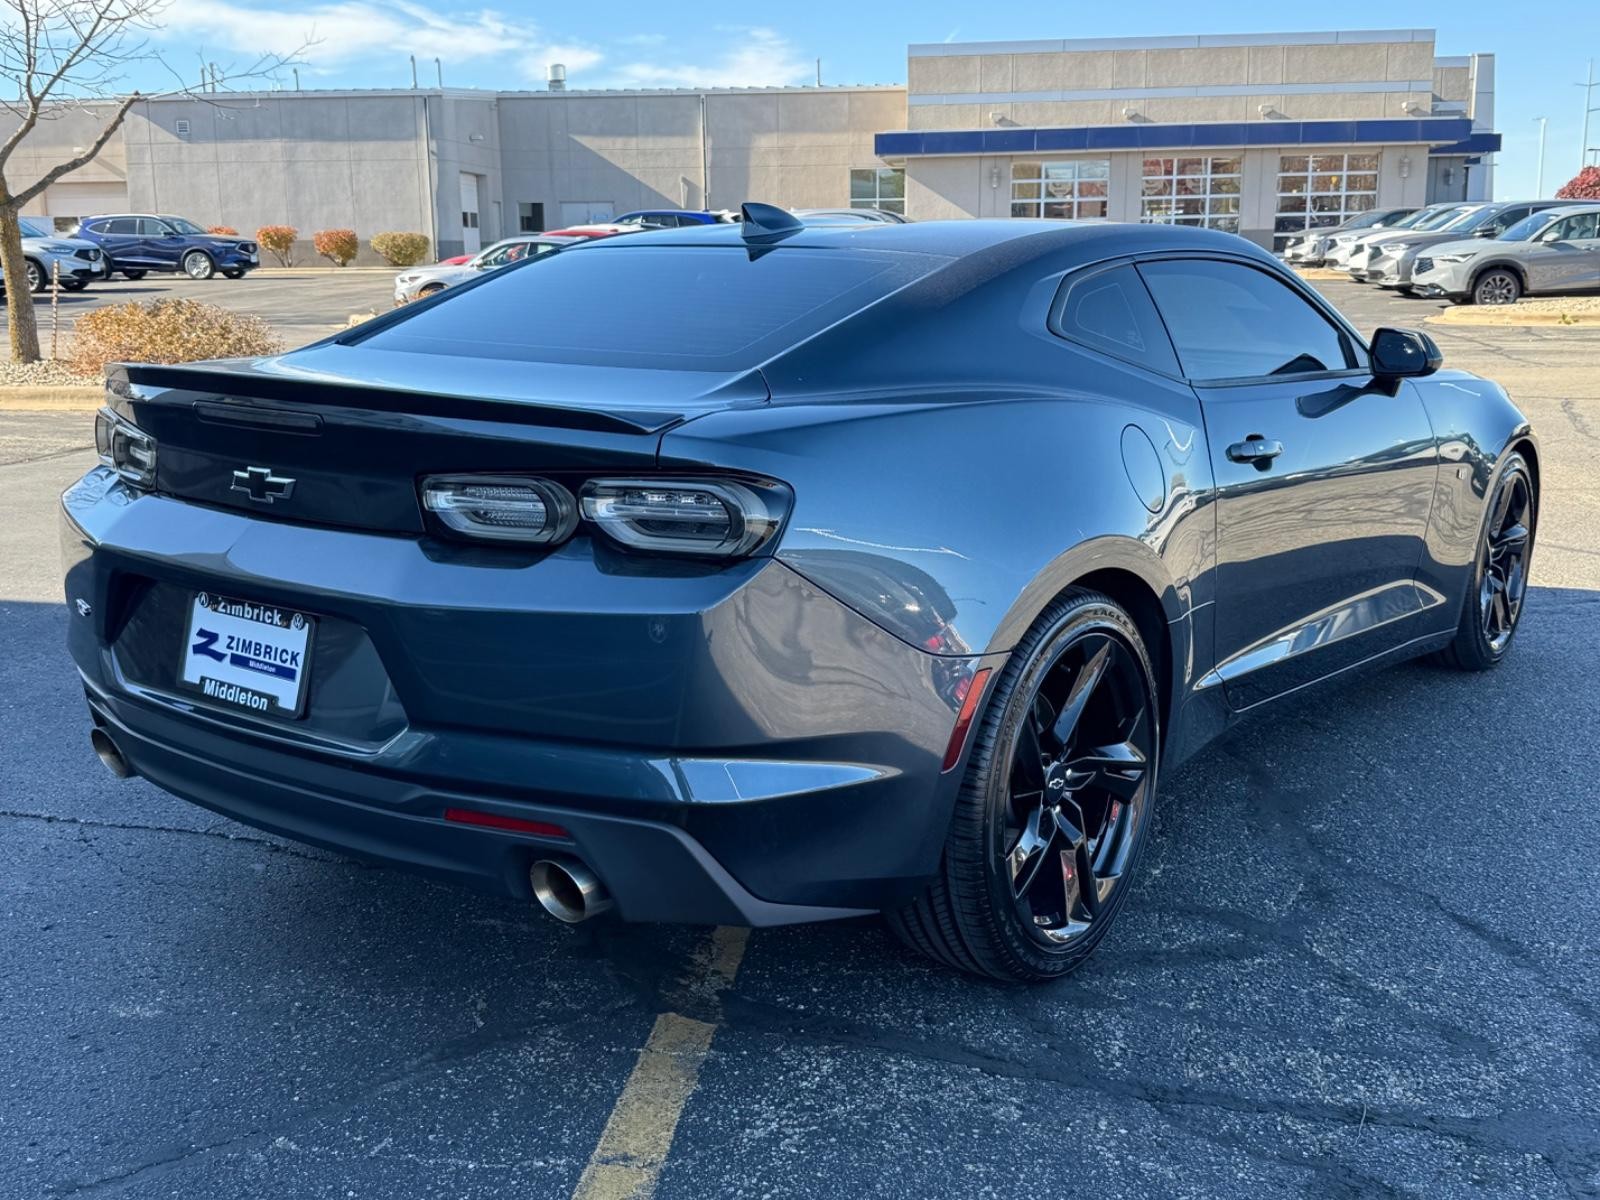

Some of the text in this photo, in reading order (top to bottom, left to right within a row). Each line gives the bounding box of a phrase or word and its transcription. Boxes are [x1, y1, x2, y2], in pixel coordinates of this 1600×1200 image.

[217, 599, 282, 626] Zimbrick
[226, 635, 300, 667] ZIMBRICK
[204, 679, 268, 711] Middleton
